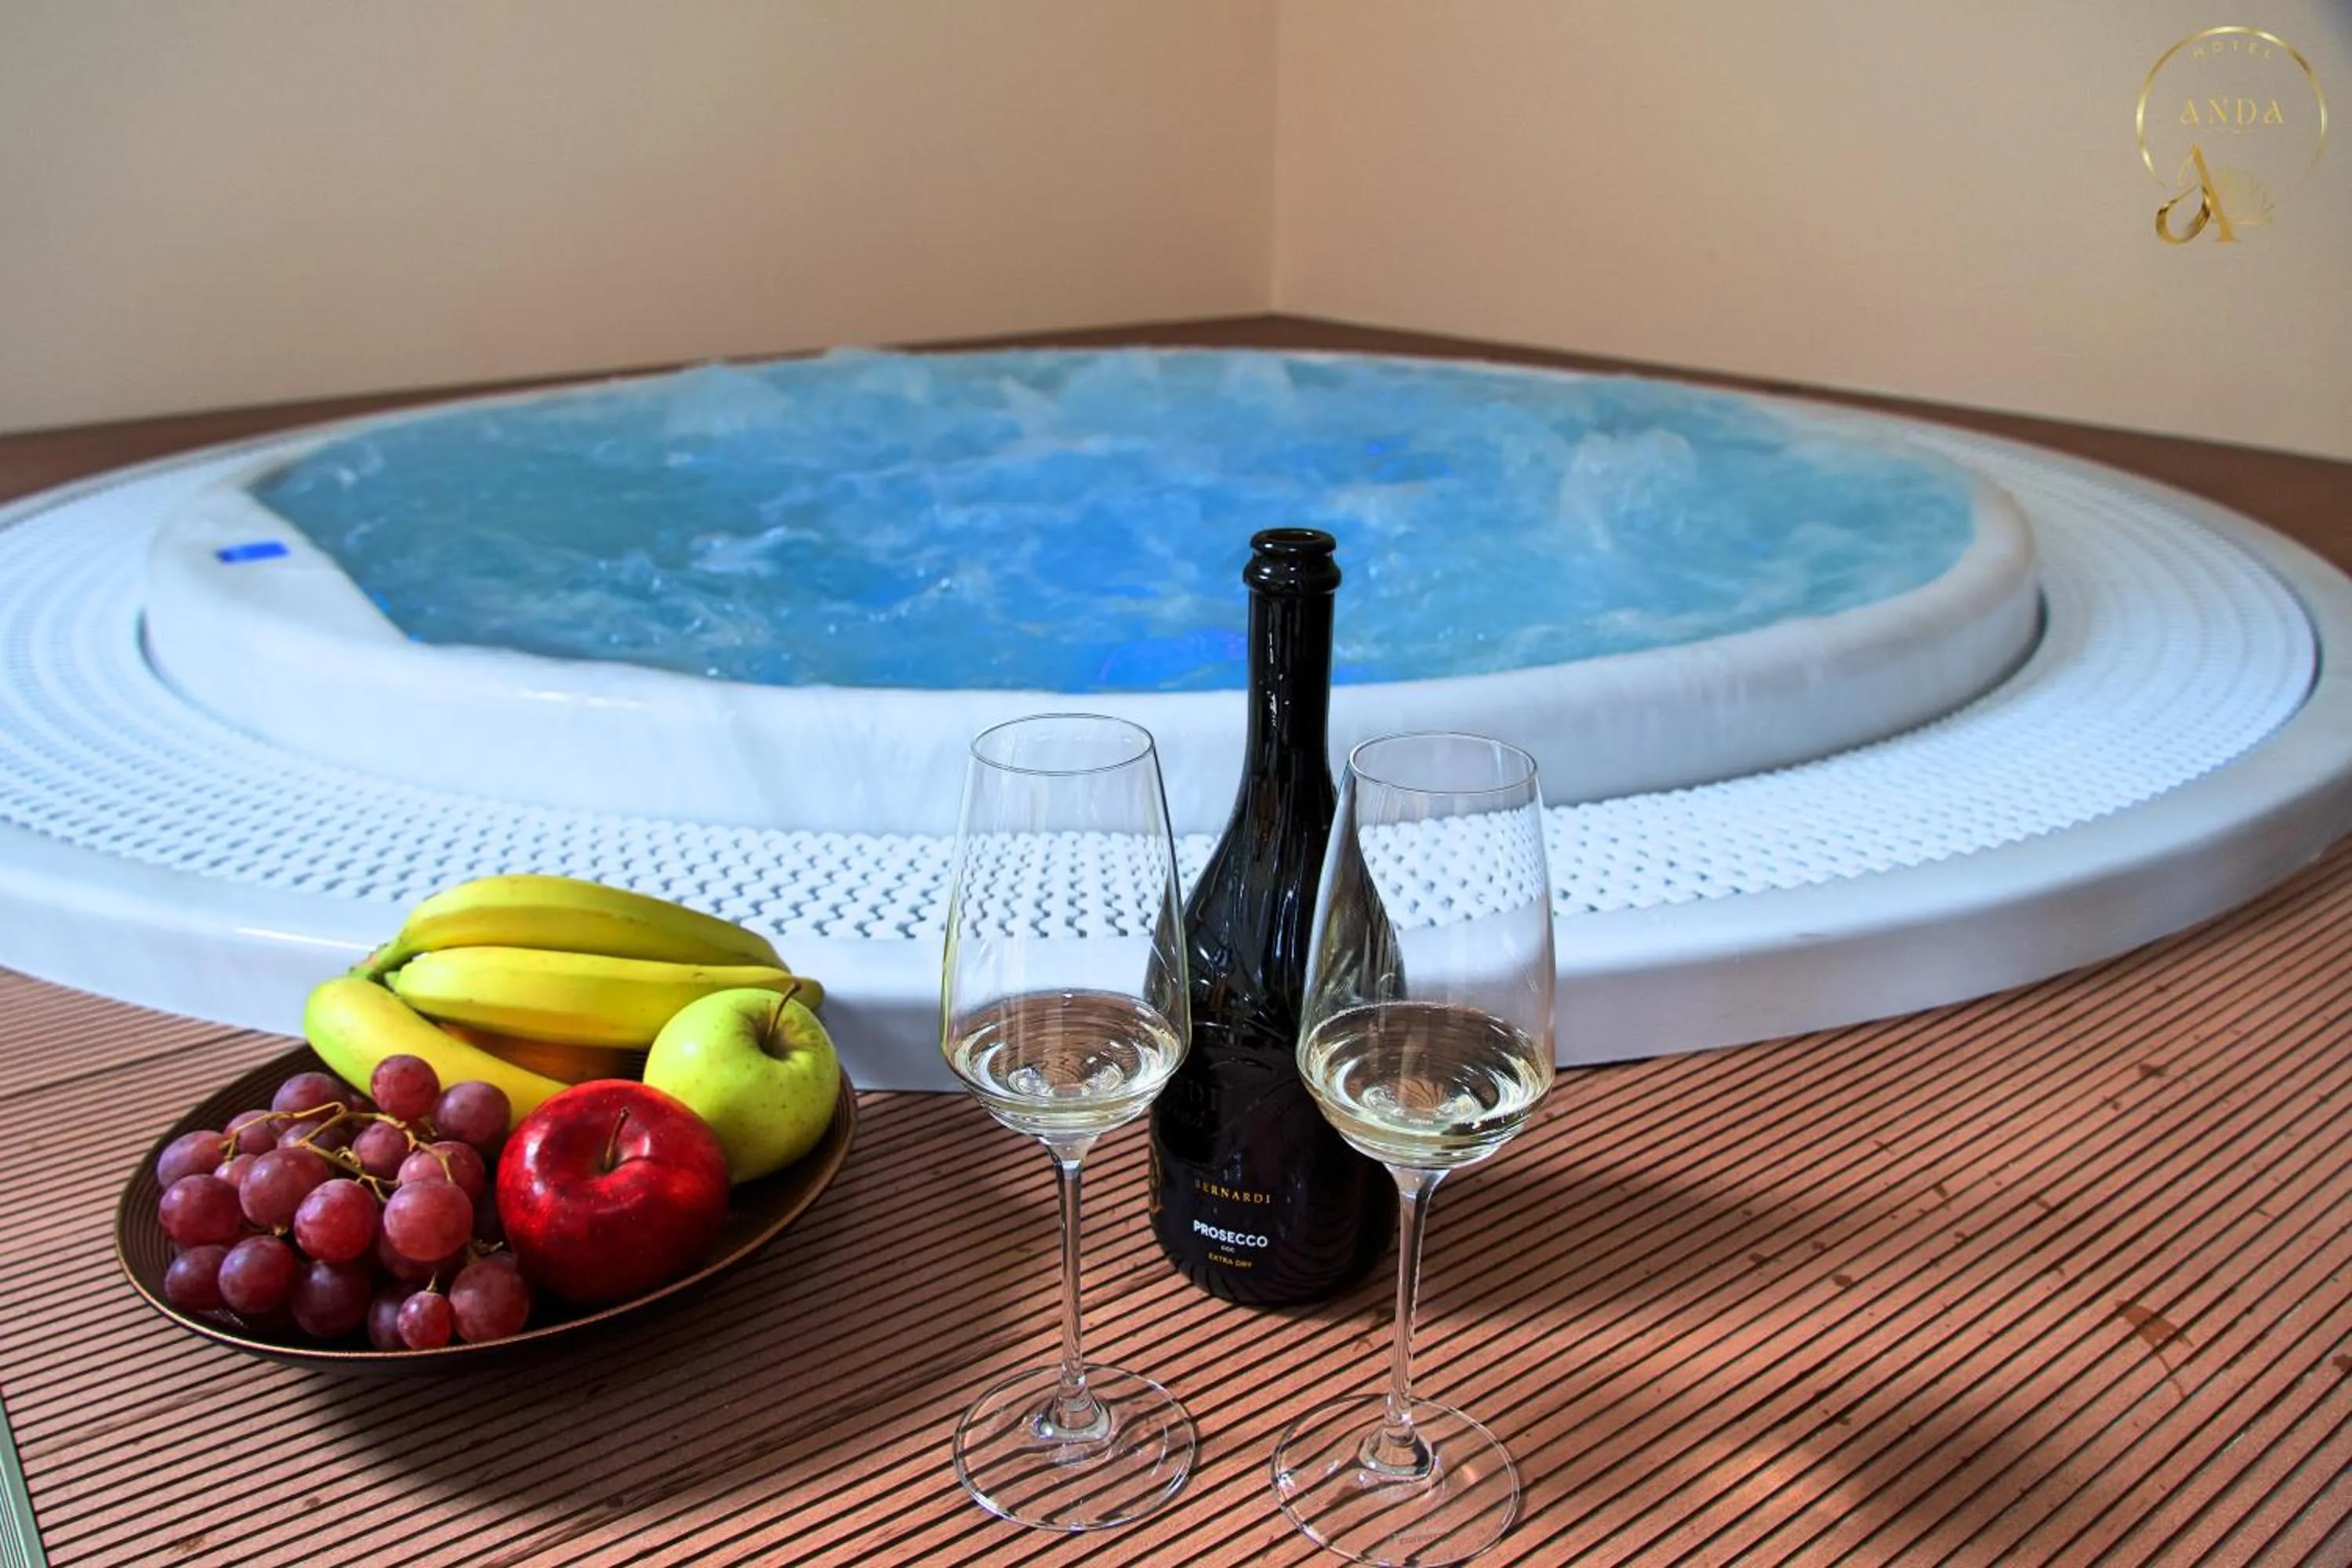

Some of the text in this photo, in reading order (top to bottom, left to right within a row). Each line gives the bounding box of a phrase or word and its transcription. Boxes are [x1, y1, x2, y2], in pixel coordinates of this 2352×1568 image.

[1195, 1178, 1271, 1204] BERNARDI
[1193, 1219, 1269, 1248] PROSECCO
[1208, 1252, 1253, 1269] EXTRA DRY
